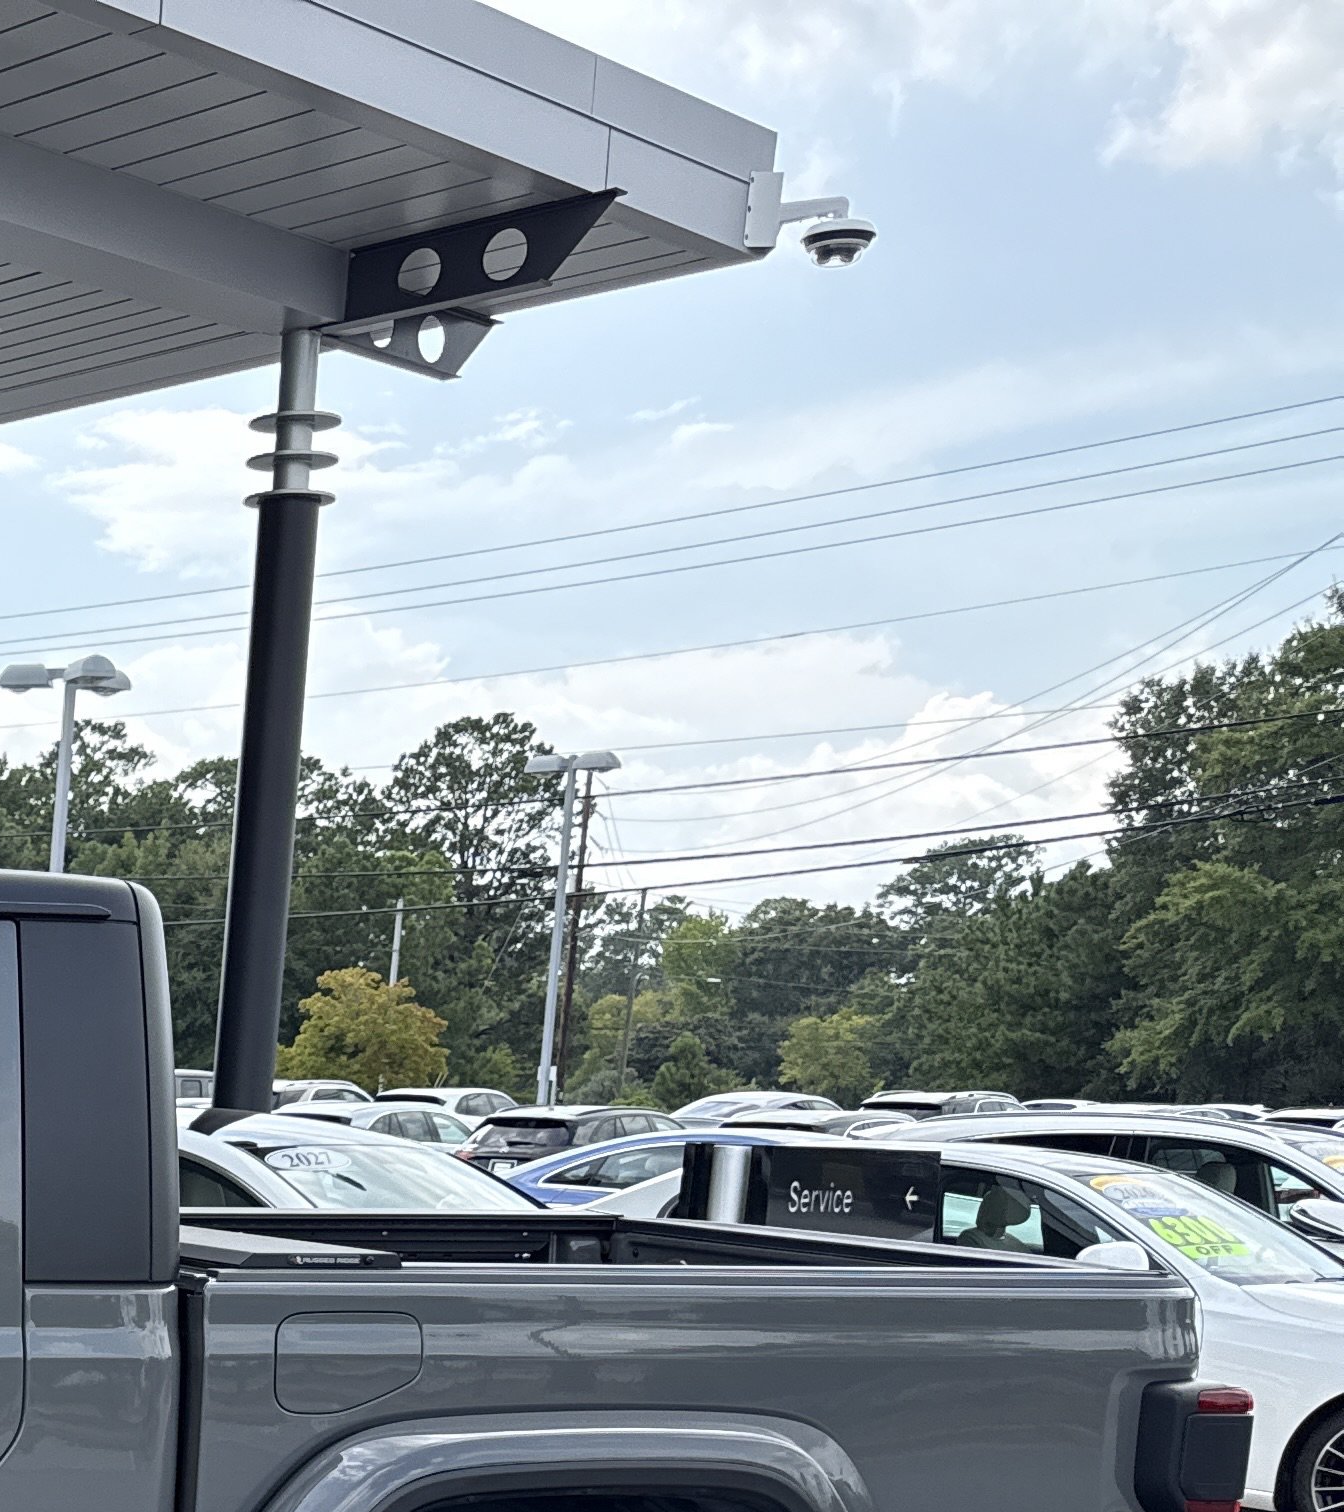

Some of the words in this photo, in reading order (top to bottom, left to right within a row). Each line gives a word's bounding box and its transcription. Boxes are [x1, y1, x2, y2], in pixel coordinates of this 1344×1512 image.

[281, 1151, 333, 1168] 2027
[787, 1180, 854, 1215] Service
[1148, 1216, 1239, 1246] 6300
[1195, 1244, 1234, 1256] OFF
